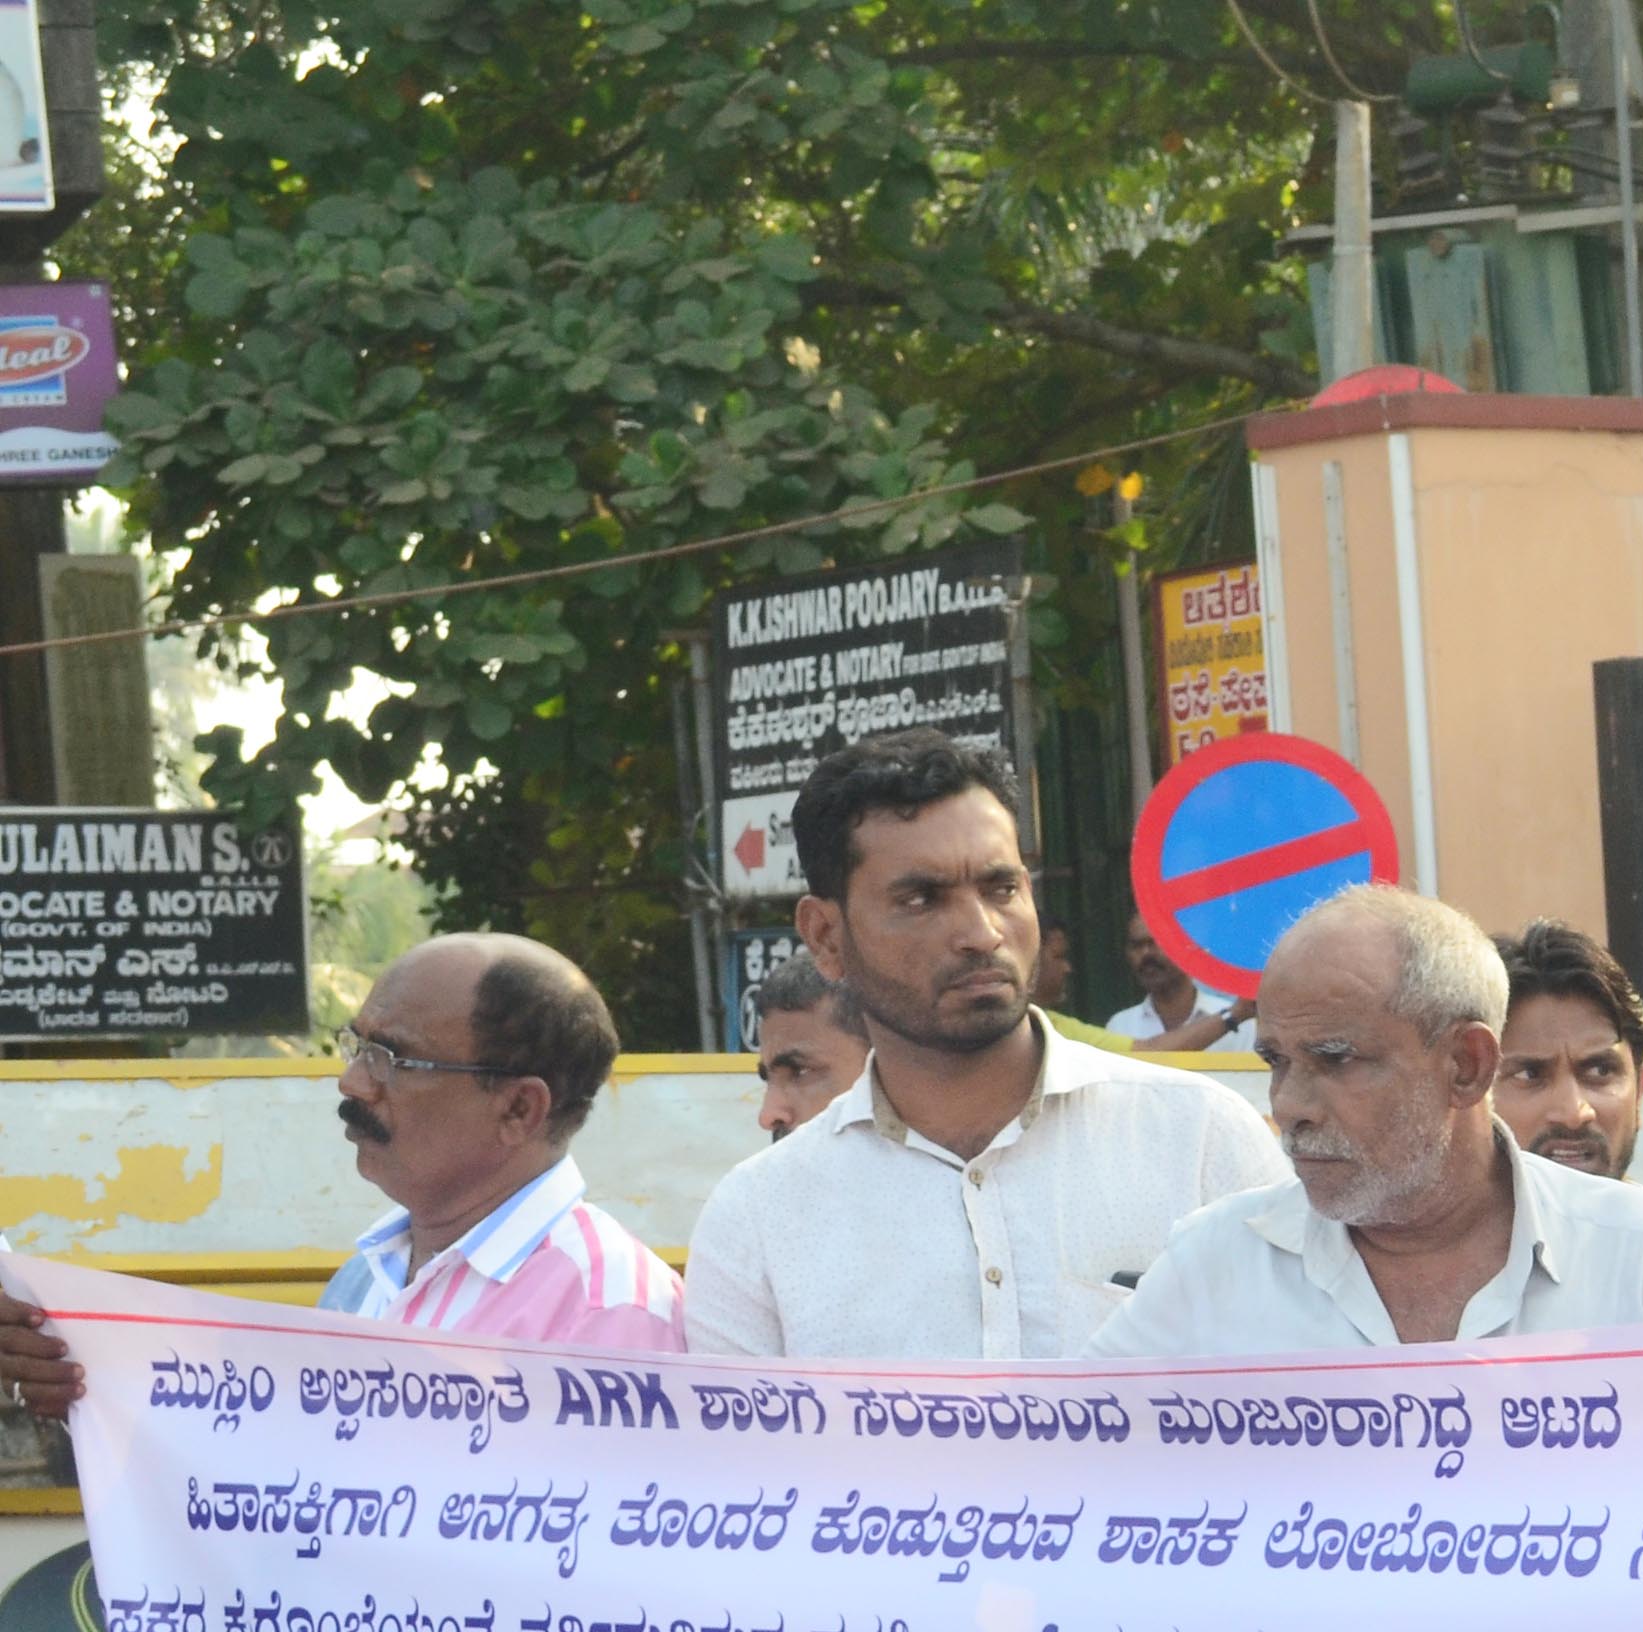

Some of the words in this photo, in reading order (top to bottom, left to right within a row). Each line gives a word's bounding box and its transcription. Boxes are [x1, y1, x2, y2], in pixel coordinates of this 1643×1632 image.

[845, 567, 939, 630] POOJARY
[729, 655, 816, 703] ADVOCATE
[820, 653, 835, 690] &
[836, 641, 904, 687] NOTARY
[95, 921, 130, 938] OF
[114, 889, 139, 918] &
[147, 890, 279, 918] NOTARY
[0, 942, 107, 979] ಮಾನ್
[149, 1347, 276, 1433] ಮುಸ್ಲಿಂ
[300, 1358, 530, 1455] ಅಲ್ಪಸಂಖ್ಯಾತ
[554, 1366, 680, 1430] ARK
[843, 1386, 1131, 1445] ಸರಕಾರದಿಂದ
[1149, 1385, 1473, 1480] ಮಂಜೂರಾಗಿದ್ದ
[1501, 1380, 1622, 1449] ಆಟದ
[186, 1468, 418, 1560] ಹಿತಾಸಕ್ತಿಗಾಗಿ
[438, 1477, 590, 1580] ಅನಗತ್ಯ
[610, 1481, 798, 1552] ತೊಂದರೆ
[810, 1488, 1085, 1583] ಕೊಡುತ್ತಿರುವ
[1097, 1498, 1248, 1568] ಶಾಸಕ
[1264, 1500, 1612, 1579] ಲೋಬೋರವರ
